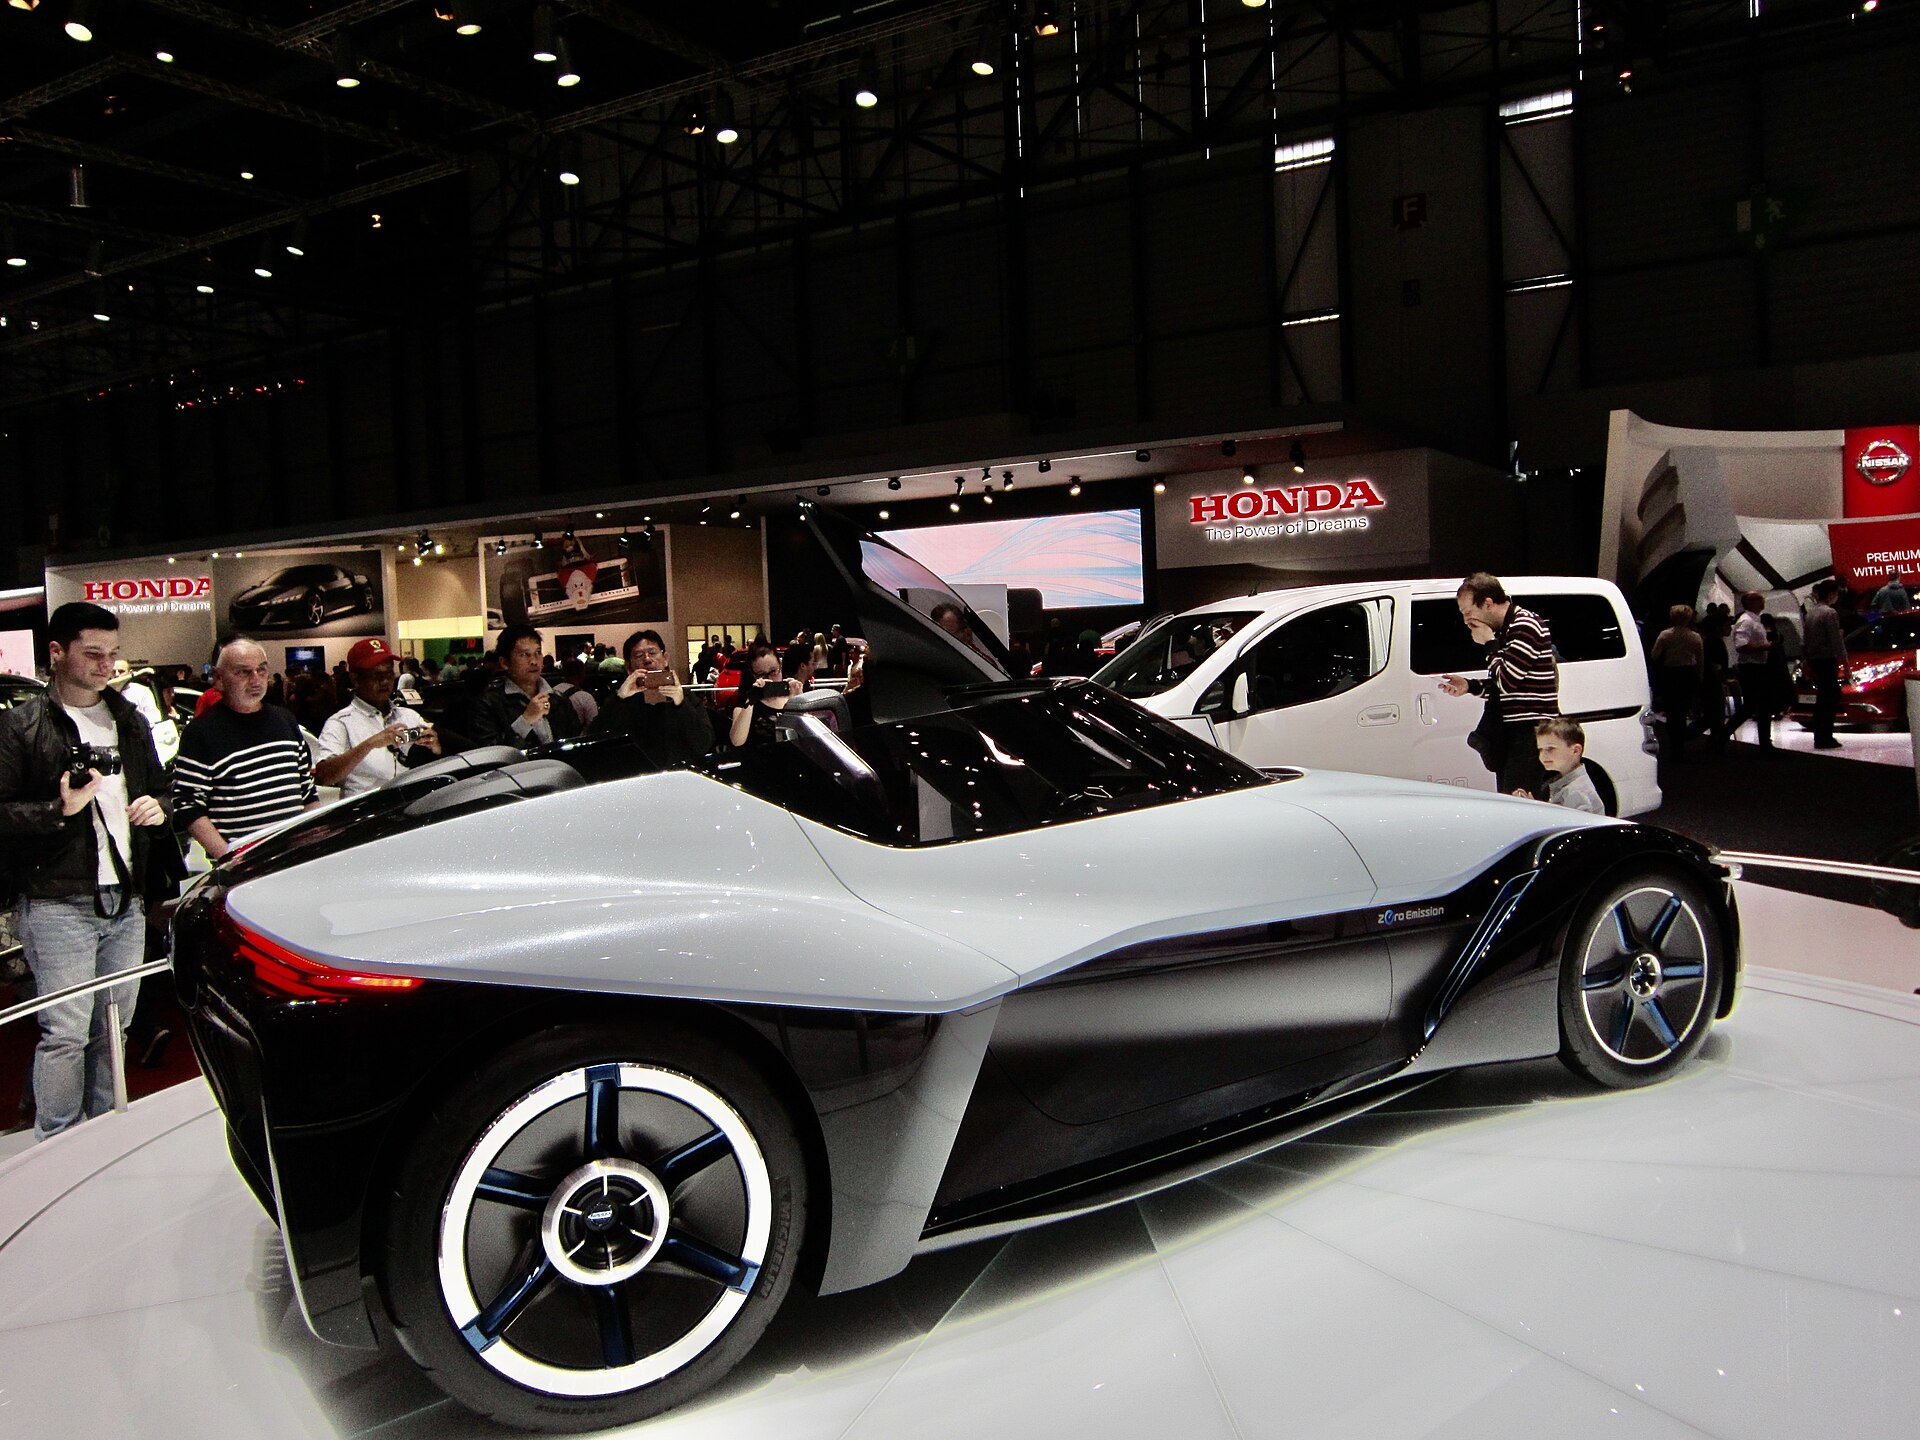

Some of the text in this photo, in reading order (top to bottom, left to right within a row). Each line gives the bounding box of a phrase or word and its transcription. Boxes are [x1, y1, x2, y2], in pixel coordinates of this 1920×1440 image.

[1402, 197, 1419, 222] F
[1861, 456, 1909, 468] NISSAN
[1189, 480, 1385, 523] HONDA
[1205, 516, 1367, 541] The Power of Dreams
[1866, 549, 1920, 563] PREMIUM
[1853, 565, 1884, 578] WITH
[119, 602, 153, 613] Power
[155, 601, 168, 612] of
[1405, 906, 1444, 920] Emission
